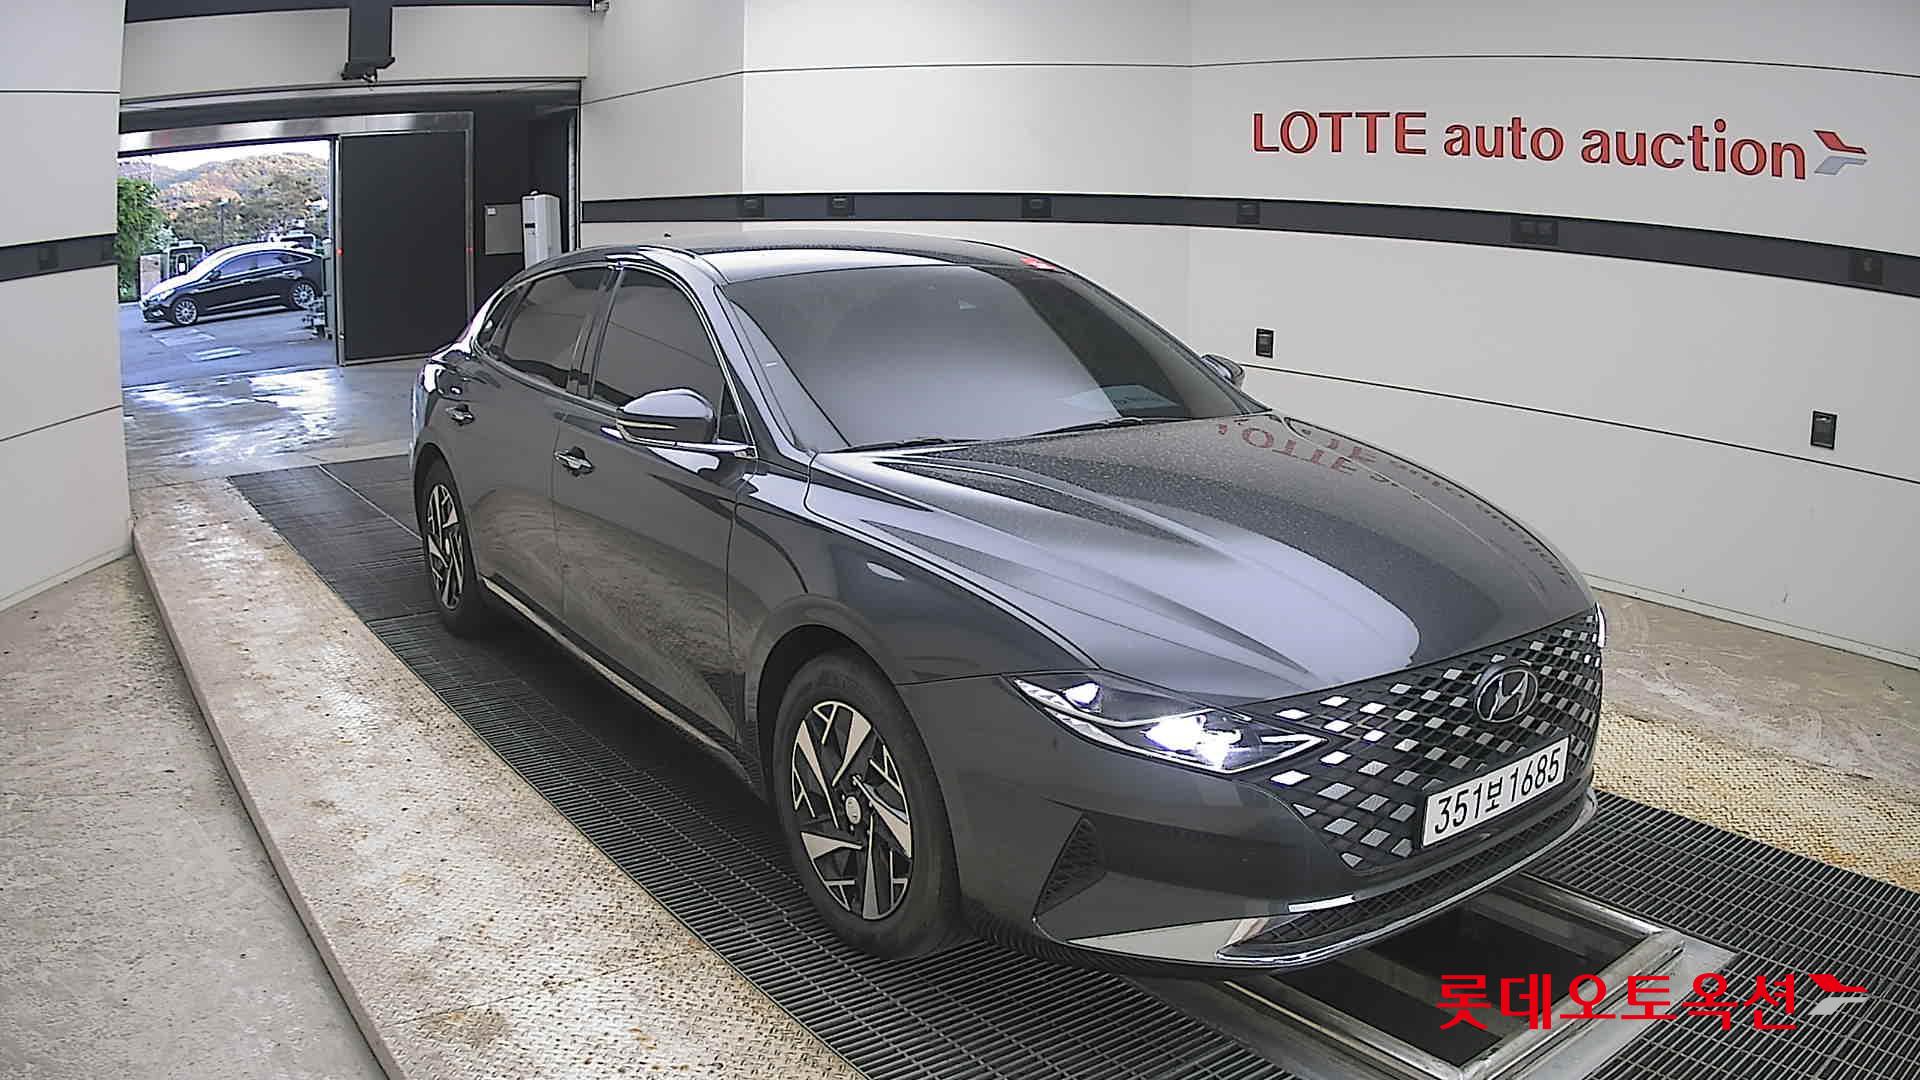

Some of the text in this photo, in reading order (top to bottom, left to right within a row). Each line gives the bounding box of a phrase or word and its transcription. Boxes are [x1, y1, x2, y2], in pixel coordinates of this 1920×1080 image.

[1252, 110, 1807, 181] LOTTE auto auction
